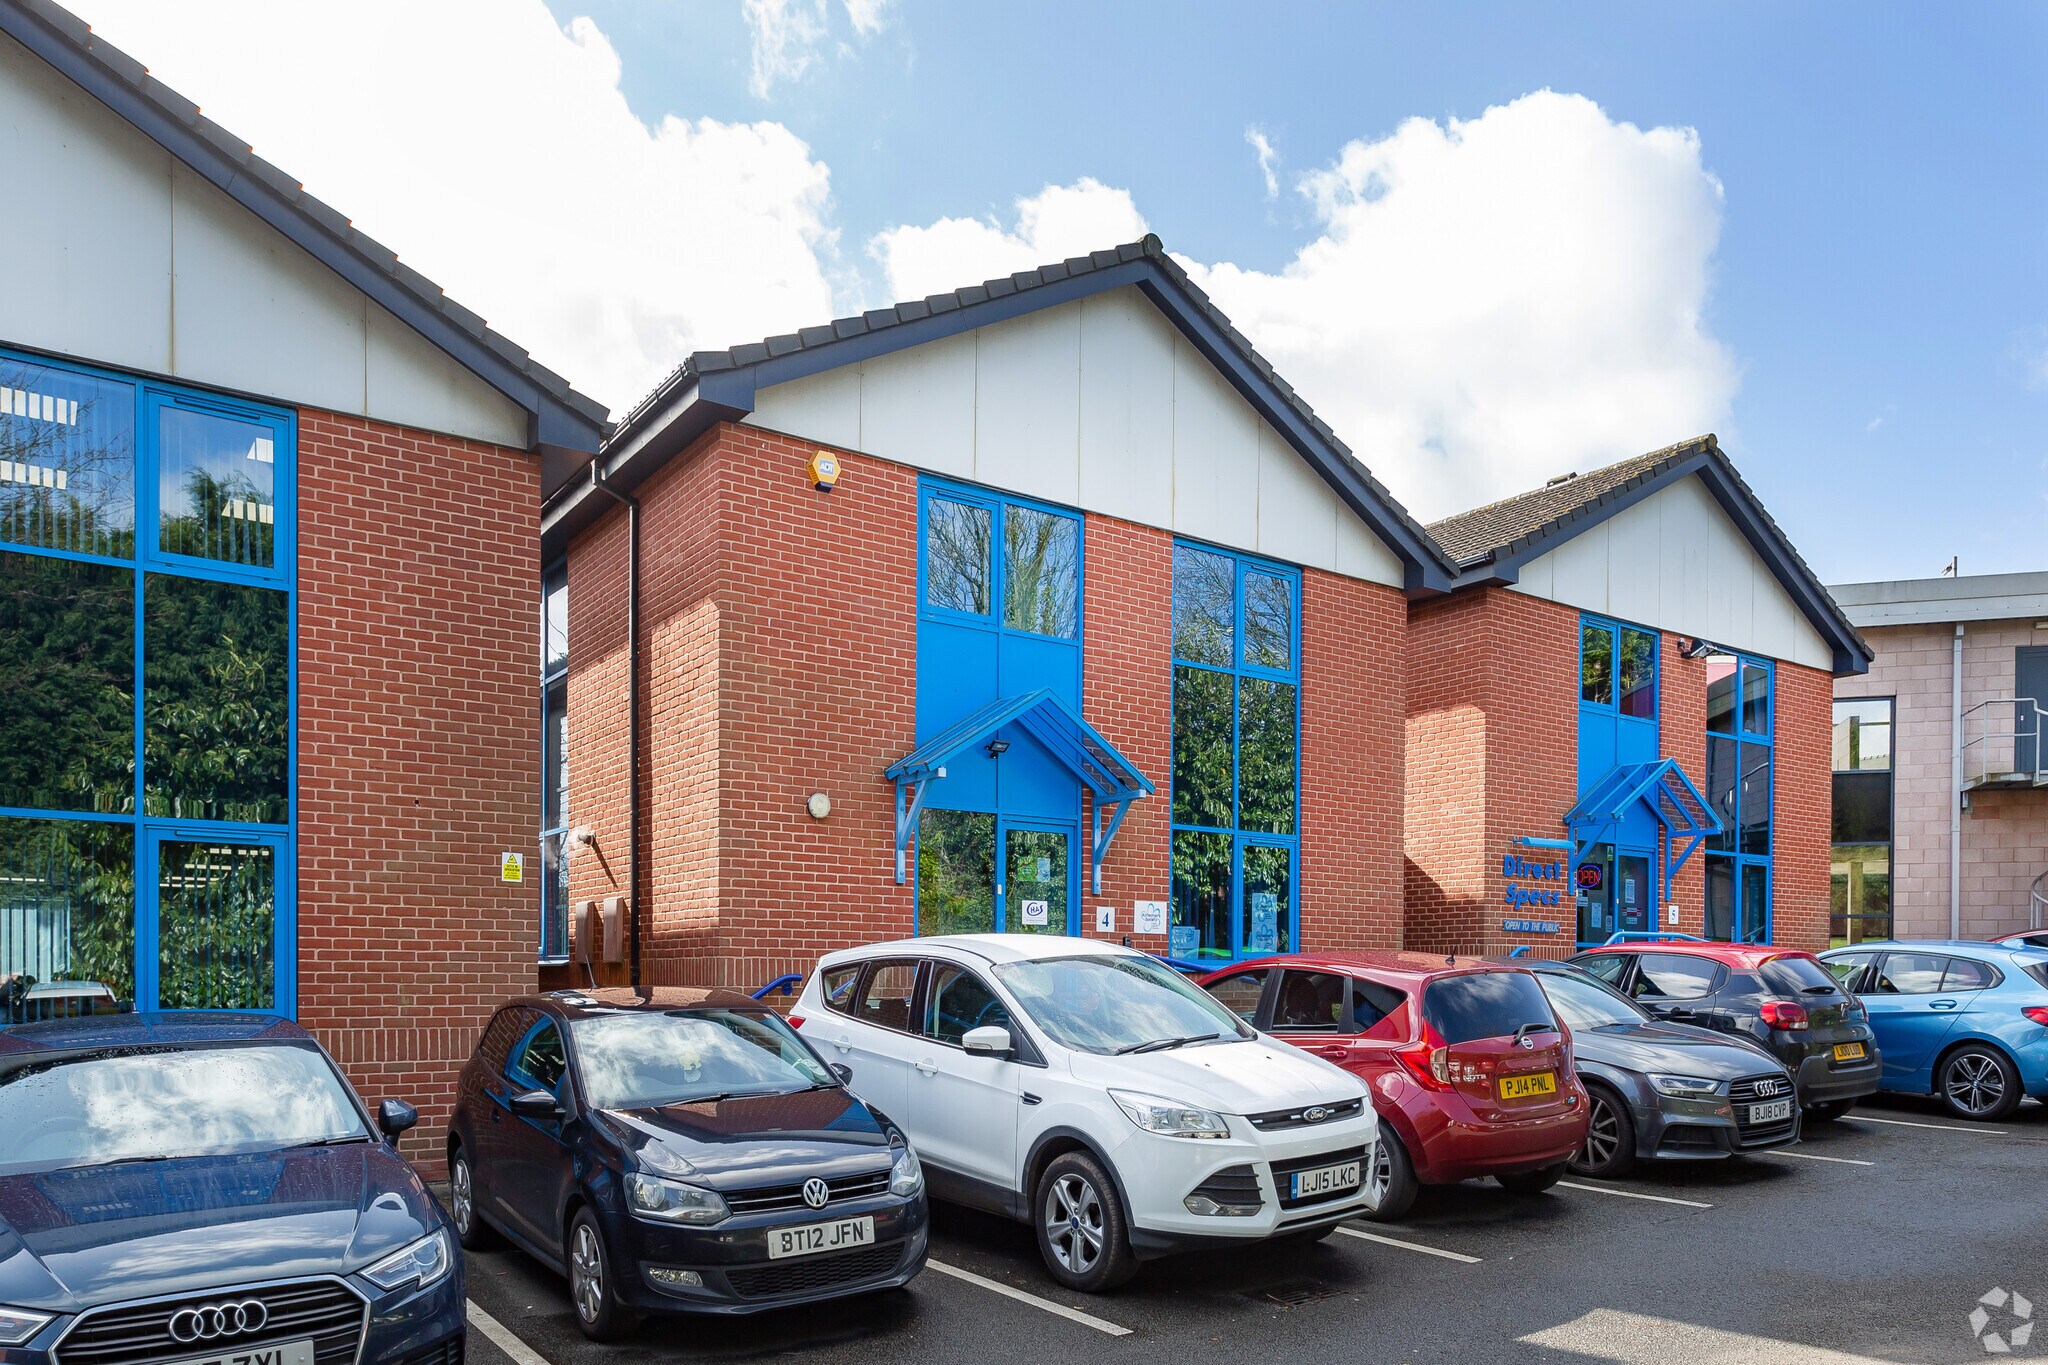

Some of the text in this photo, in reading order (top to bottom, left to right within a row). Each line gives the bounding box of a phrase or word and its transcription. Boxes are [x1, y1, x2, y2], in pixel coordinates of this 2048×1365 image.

[820, 462, 834, 473] ADT
[1503, 855, 1561, 880] Direct
[1577, 869, 1601, 885] OPEN
[1505, 883, 1560, 910] Specs
[1026, 902, 1043, 916] CHAS
[1102, 912, 1109, 927] 4
[1505, 921, 1559, 932] OPEN TO THE PUBLIC
[1506, 1076, 1549, 1095] PJ14 PNL
[1310, 1109, 1324, 1119] Ford
[1755, 1106, 1772, 1120] BJ18
[1302, 1167, 1355, 1193] LJ15 LKC
[781, 1221, 864, 1253] BT12 JFN
